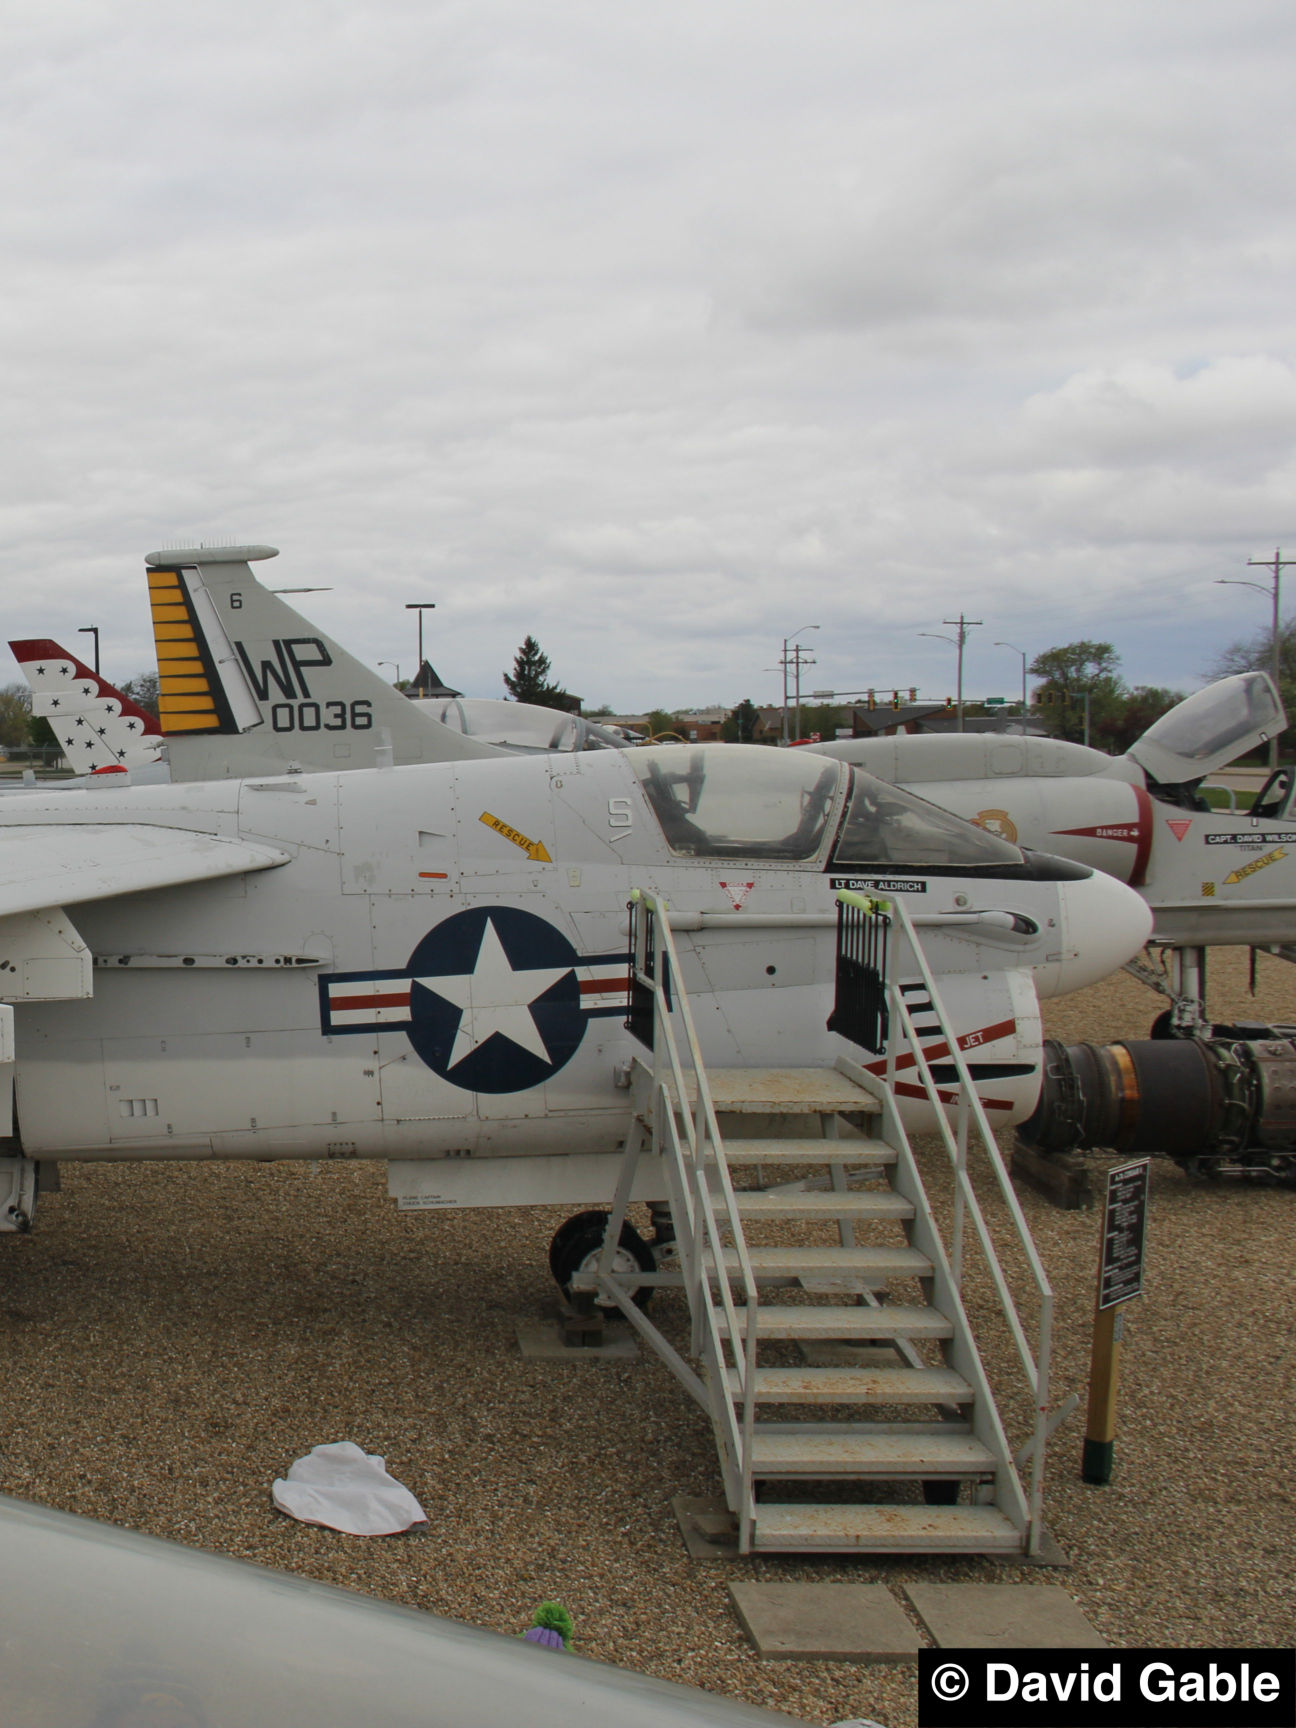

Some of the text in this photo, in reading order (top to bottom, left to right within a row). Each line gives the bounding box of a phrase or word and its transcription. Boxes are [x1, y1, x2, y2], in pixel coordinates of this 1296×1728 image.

[230, 592, 242, 609] 6
[234, 637, 333, 701] WP
[272, 700, 372, 732] 0036
[491, 819, 534, 851] RESCUE
[1095, 827, 1129, 837] DANGER
[1208, 835, 1234, 843] CAPT.
[1236, 834, 1262, 843] DAVID
[1236, 855, 1275, 879] RESCUE
[835, 879, 922, 892] LT DAVE ALDRICH
[963, 1031, 984, 1049] JET
